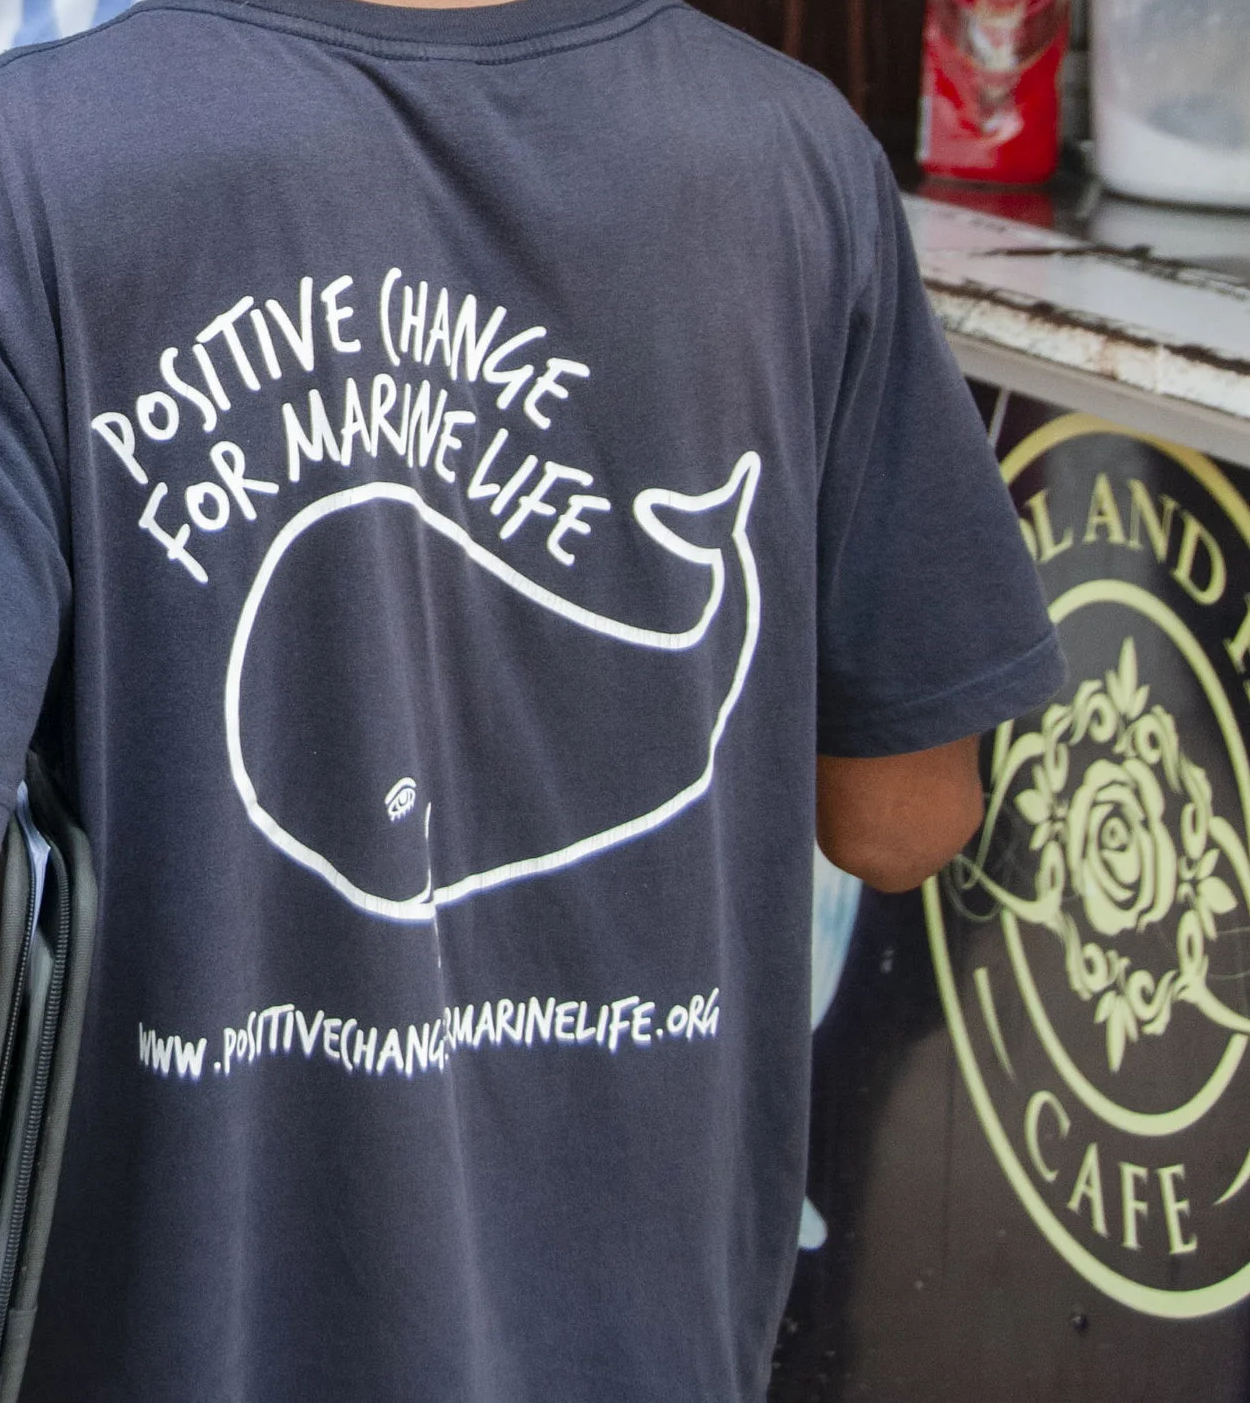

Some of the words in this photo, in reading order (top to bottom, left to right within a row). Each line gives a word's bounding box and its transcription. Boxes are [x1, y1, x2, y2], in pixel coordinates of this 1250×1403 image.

[91, 275, 361, 485] POSITIVE
[379, 267, 591, 429] CHANGE
[137, 440, 280, 585] FOR
[281, 373, 476, 483] MARINE
[466, 428, 612, 567] LIFE
[1026, 1090, 1198, 1257] CAFE
